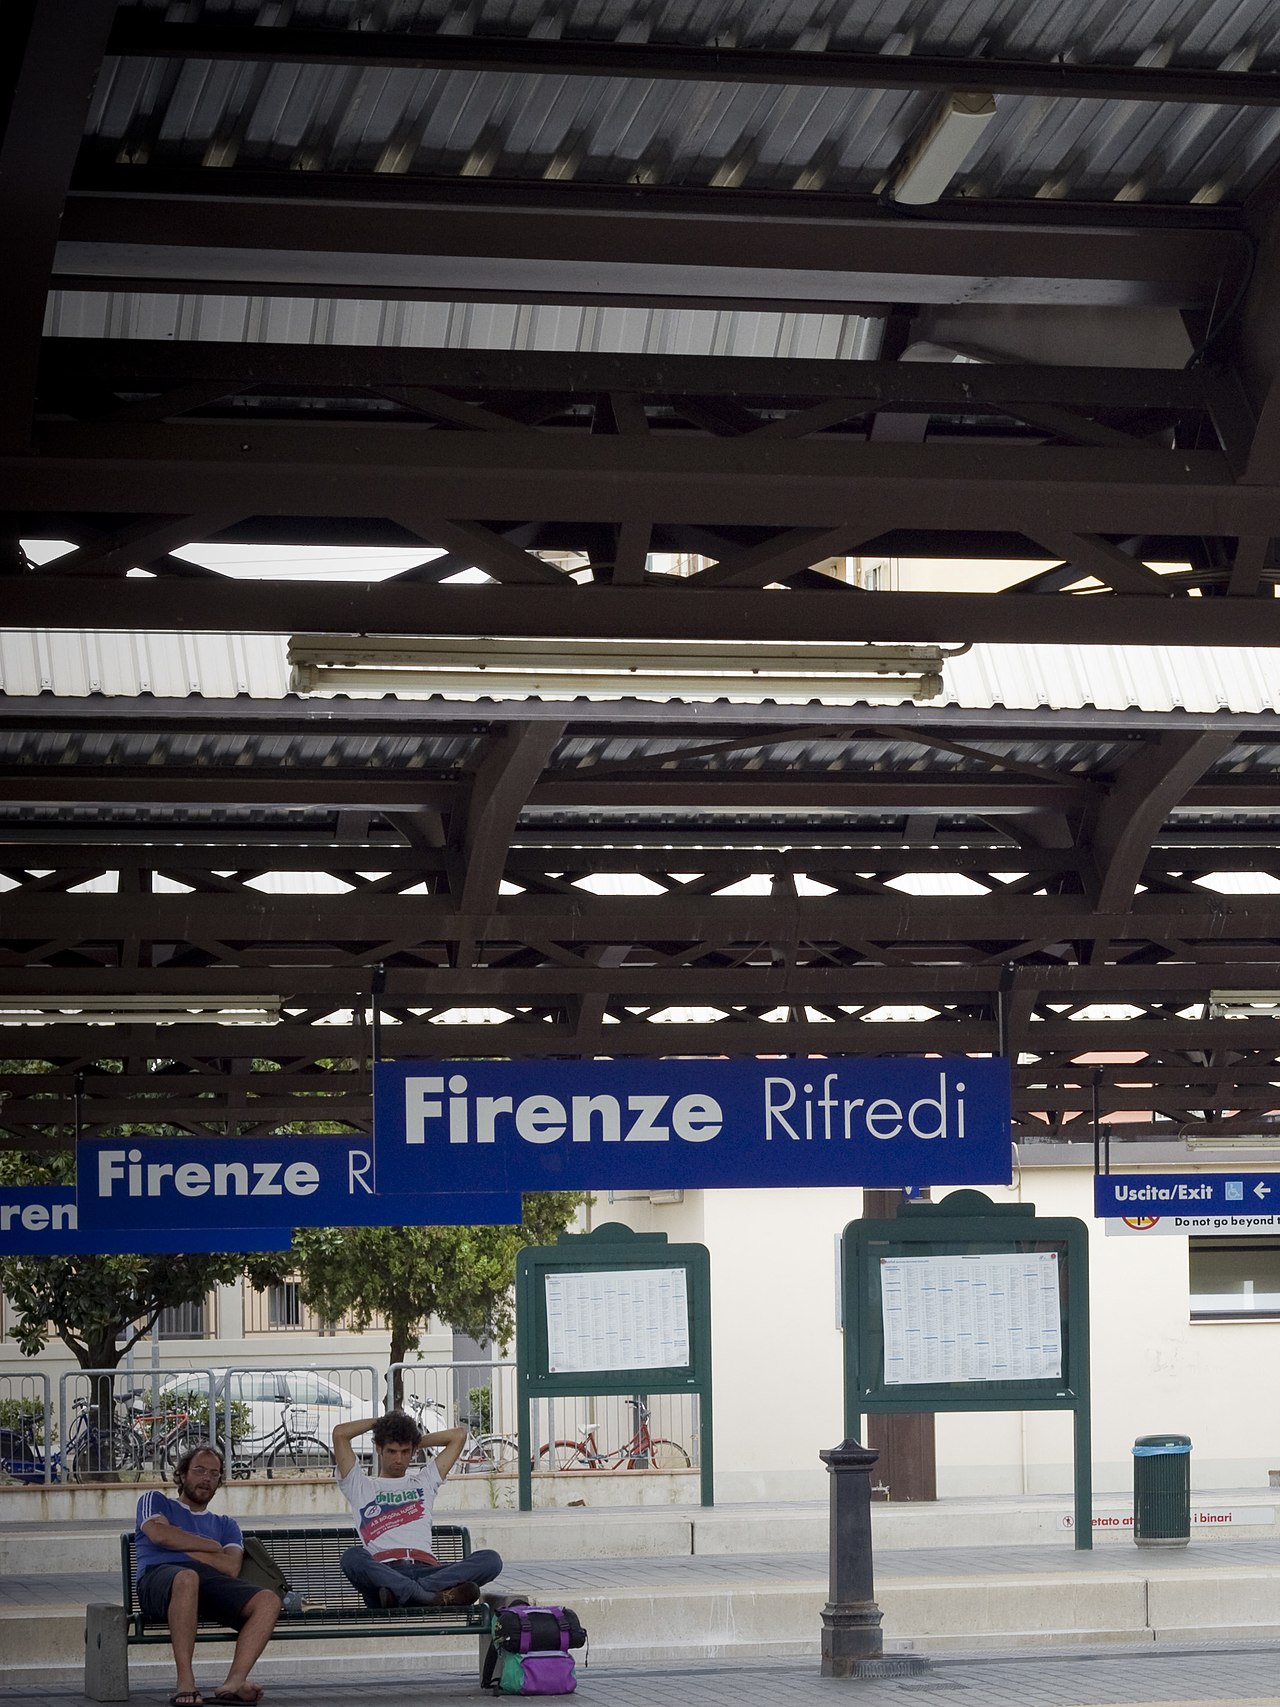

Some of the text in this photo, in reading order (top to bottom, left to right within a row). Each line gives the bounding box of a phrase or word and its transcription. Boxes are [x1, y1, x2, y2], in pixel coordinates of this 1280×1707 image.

[405, 1072, 966, 1144] Firenze Rifredi
[98, 1149, 320, 1197] Firenze
[1114, 1184, 1213, 1202] Uscita/Exit
[1174, 1217, 1190, 1227] Do
[1193, 1217, 1211, 1227] not
[1213, 1218, 1228, 1229] go
[1231, 1215, 1274, 1228] beyond
[1091, 1517, 1120, 1526] etato
[1200, 1512, 1233, 1523] binari
